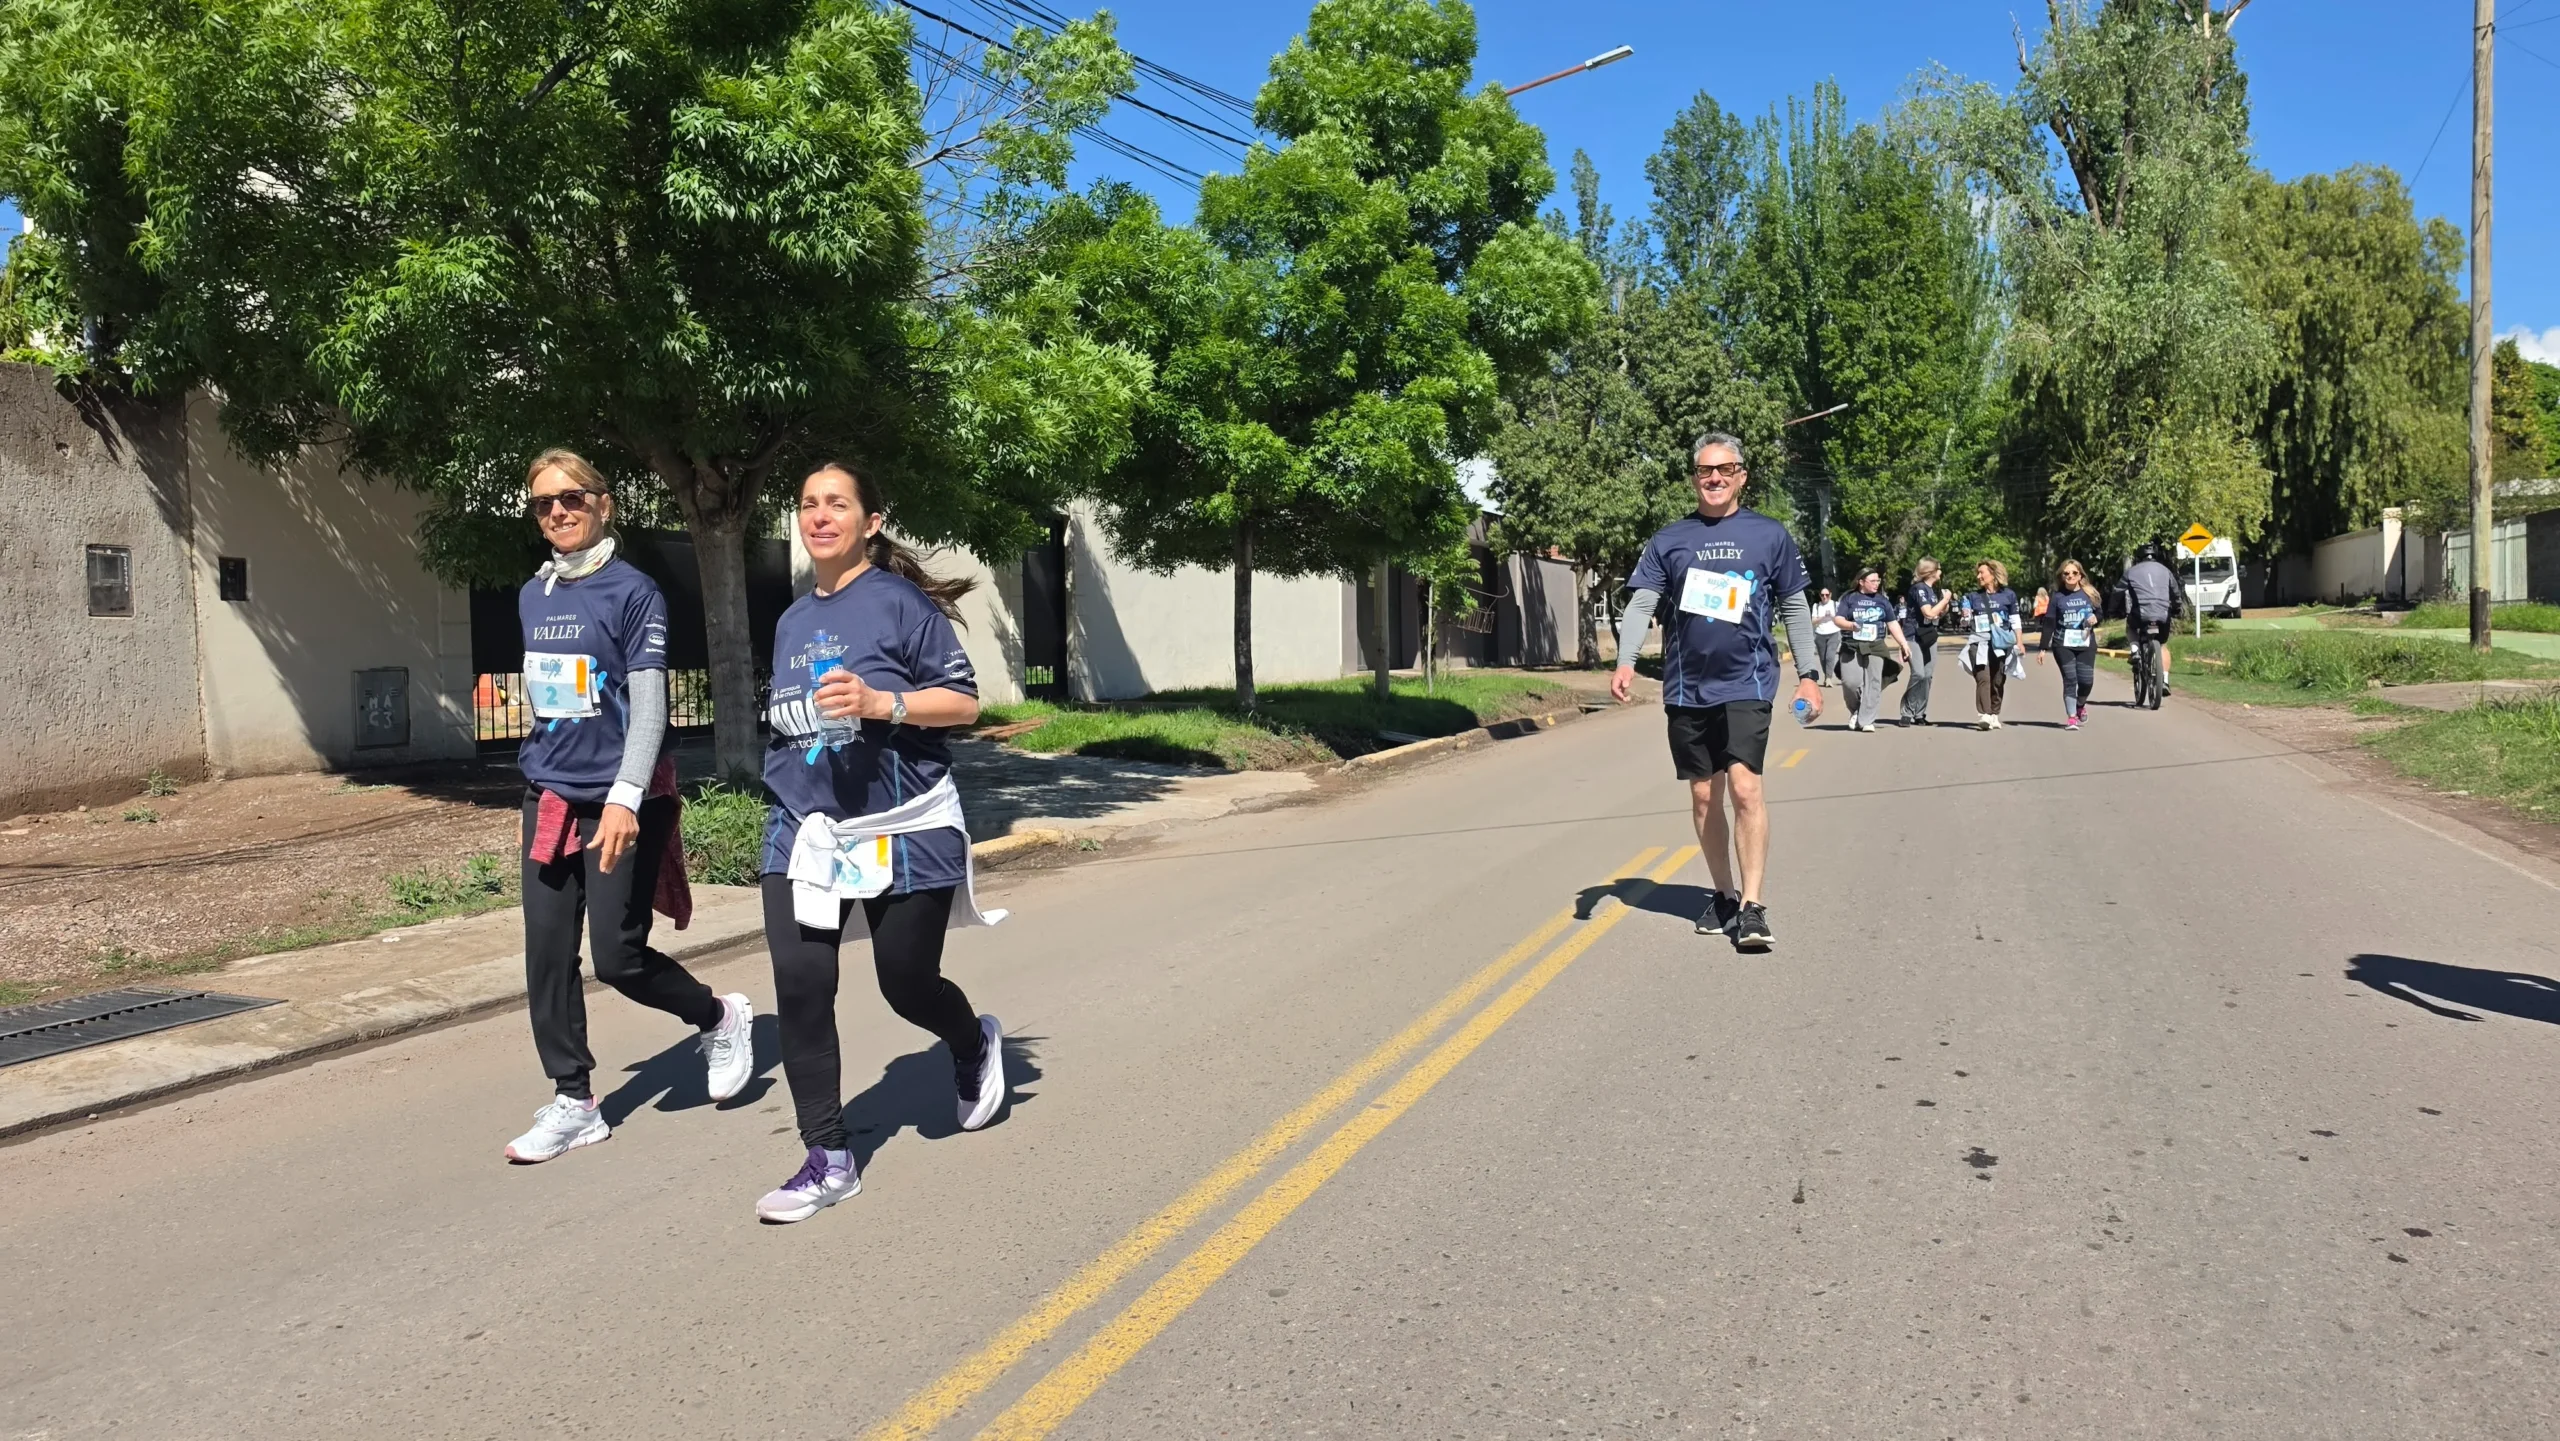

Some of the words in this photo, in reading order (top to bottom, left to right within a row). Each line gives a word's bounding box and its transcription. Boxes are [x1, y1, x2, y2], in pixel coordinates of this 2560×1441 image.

[1696, 548, 1744, 561] VALLEY
[1704, 593, 1723, 610] 19
[546, 614, 577, 622] PALMARES
[534, 625, 585, 640] VALLEY
[546, 686, 558, 705] 2
